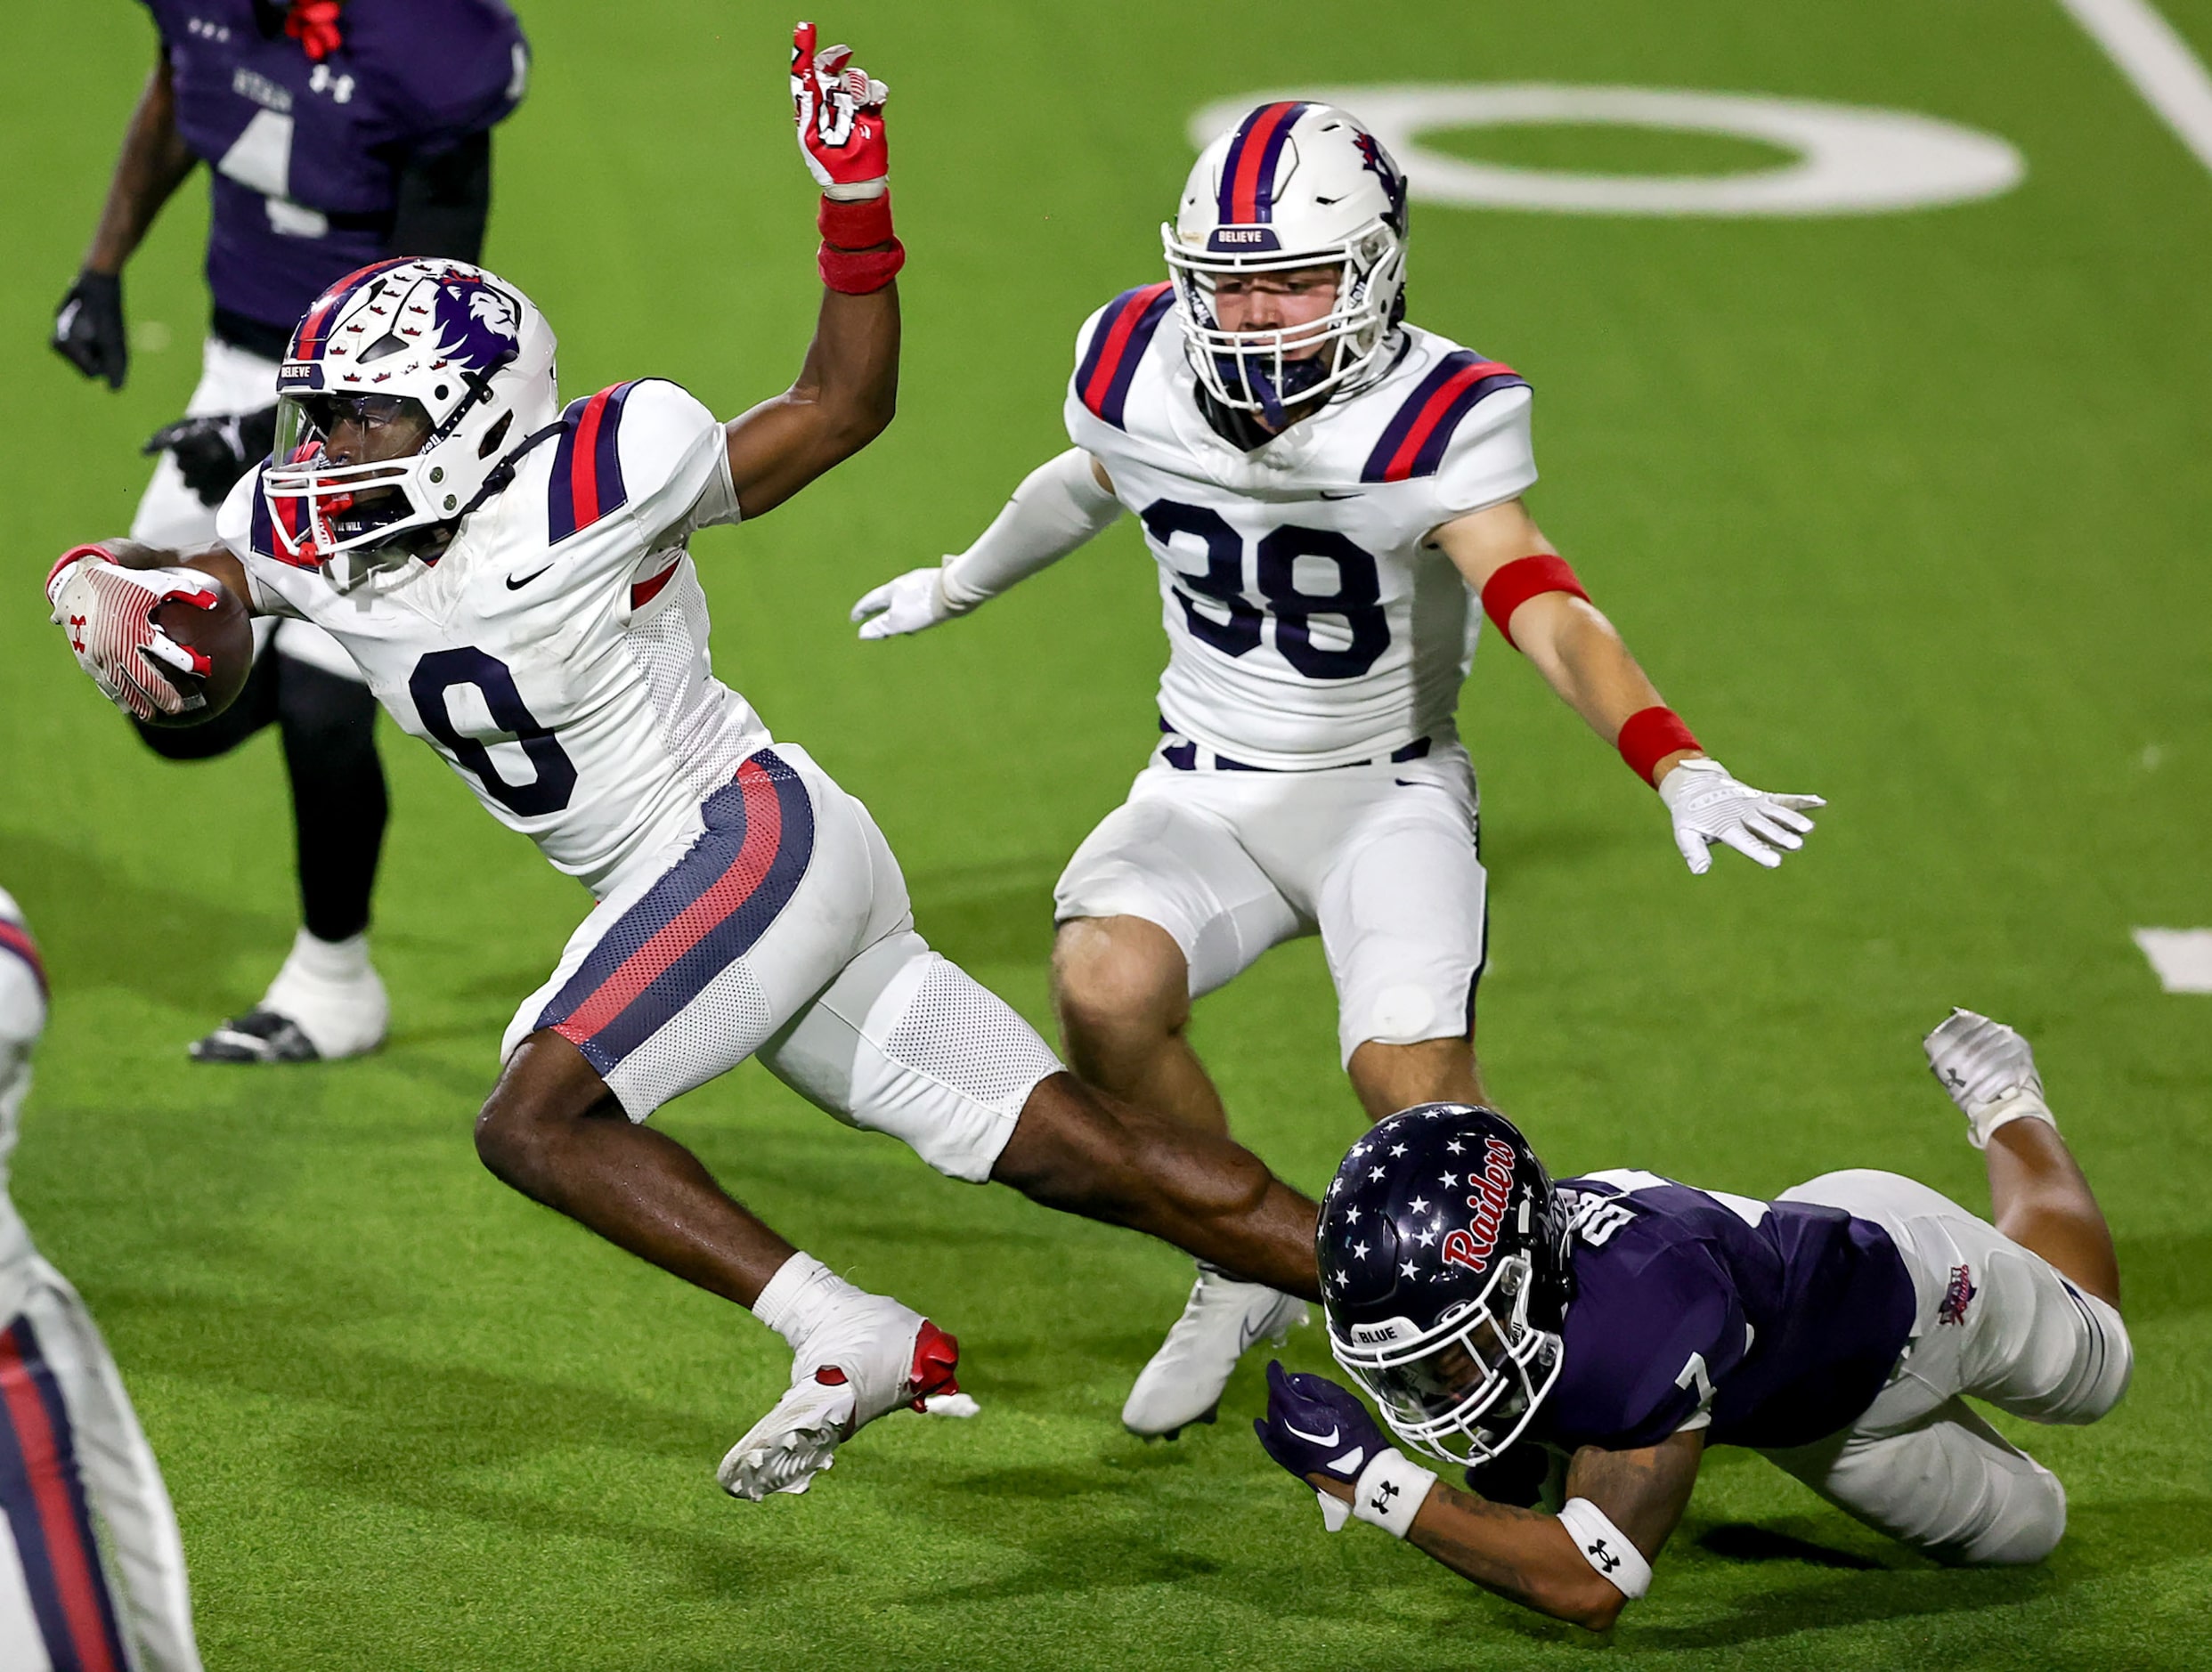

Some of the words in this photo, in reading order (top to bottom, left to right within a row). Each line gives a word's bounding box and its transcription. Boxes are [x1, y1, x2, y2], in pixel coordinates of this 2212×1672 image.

[218, 108, 329, 238] 4
[1217, 231, 1262, 243] BELIEVE
[281, 366, 311, 378] BELIEVE
[1141, 498, 1391, 679] 38
[408, 645, 578, 817] 0
[1442, 1138, 1516, 1274] Raiders
[1358, 1327, 1398, 1343] BLUE
[1675, 1351, 1717, 1408] 7
